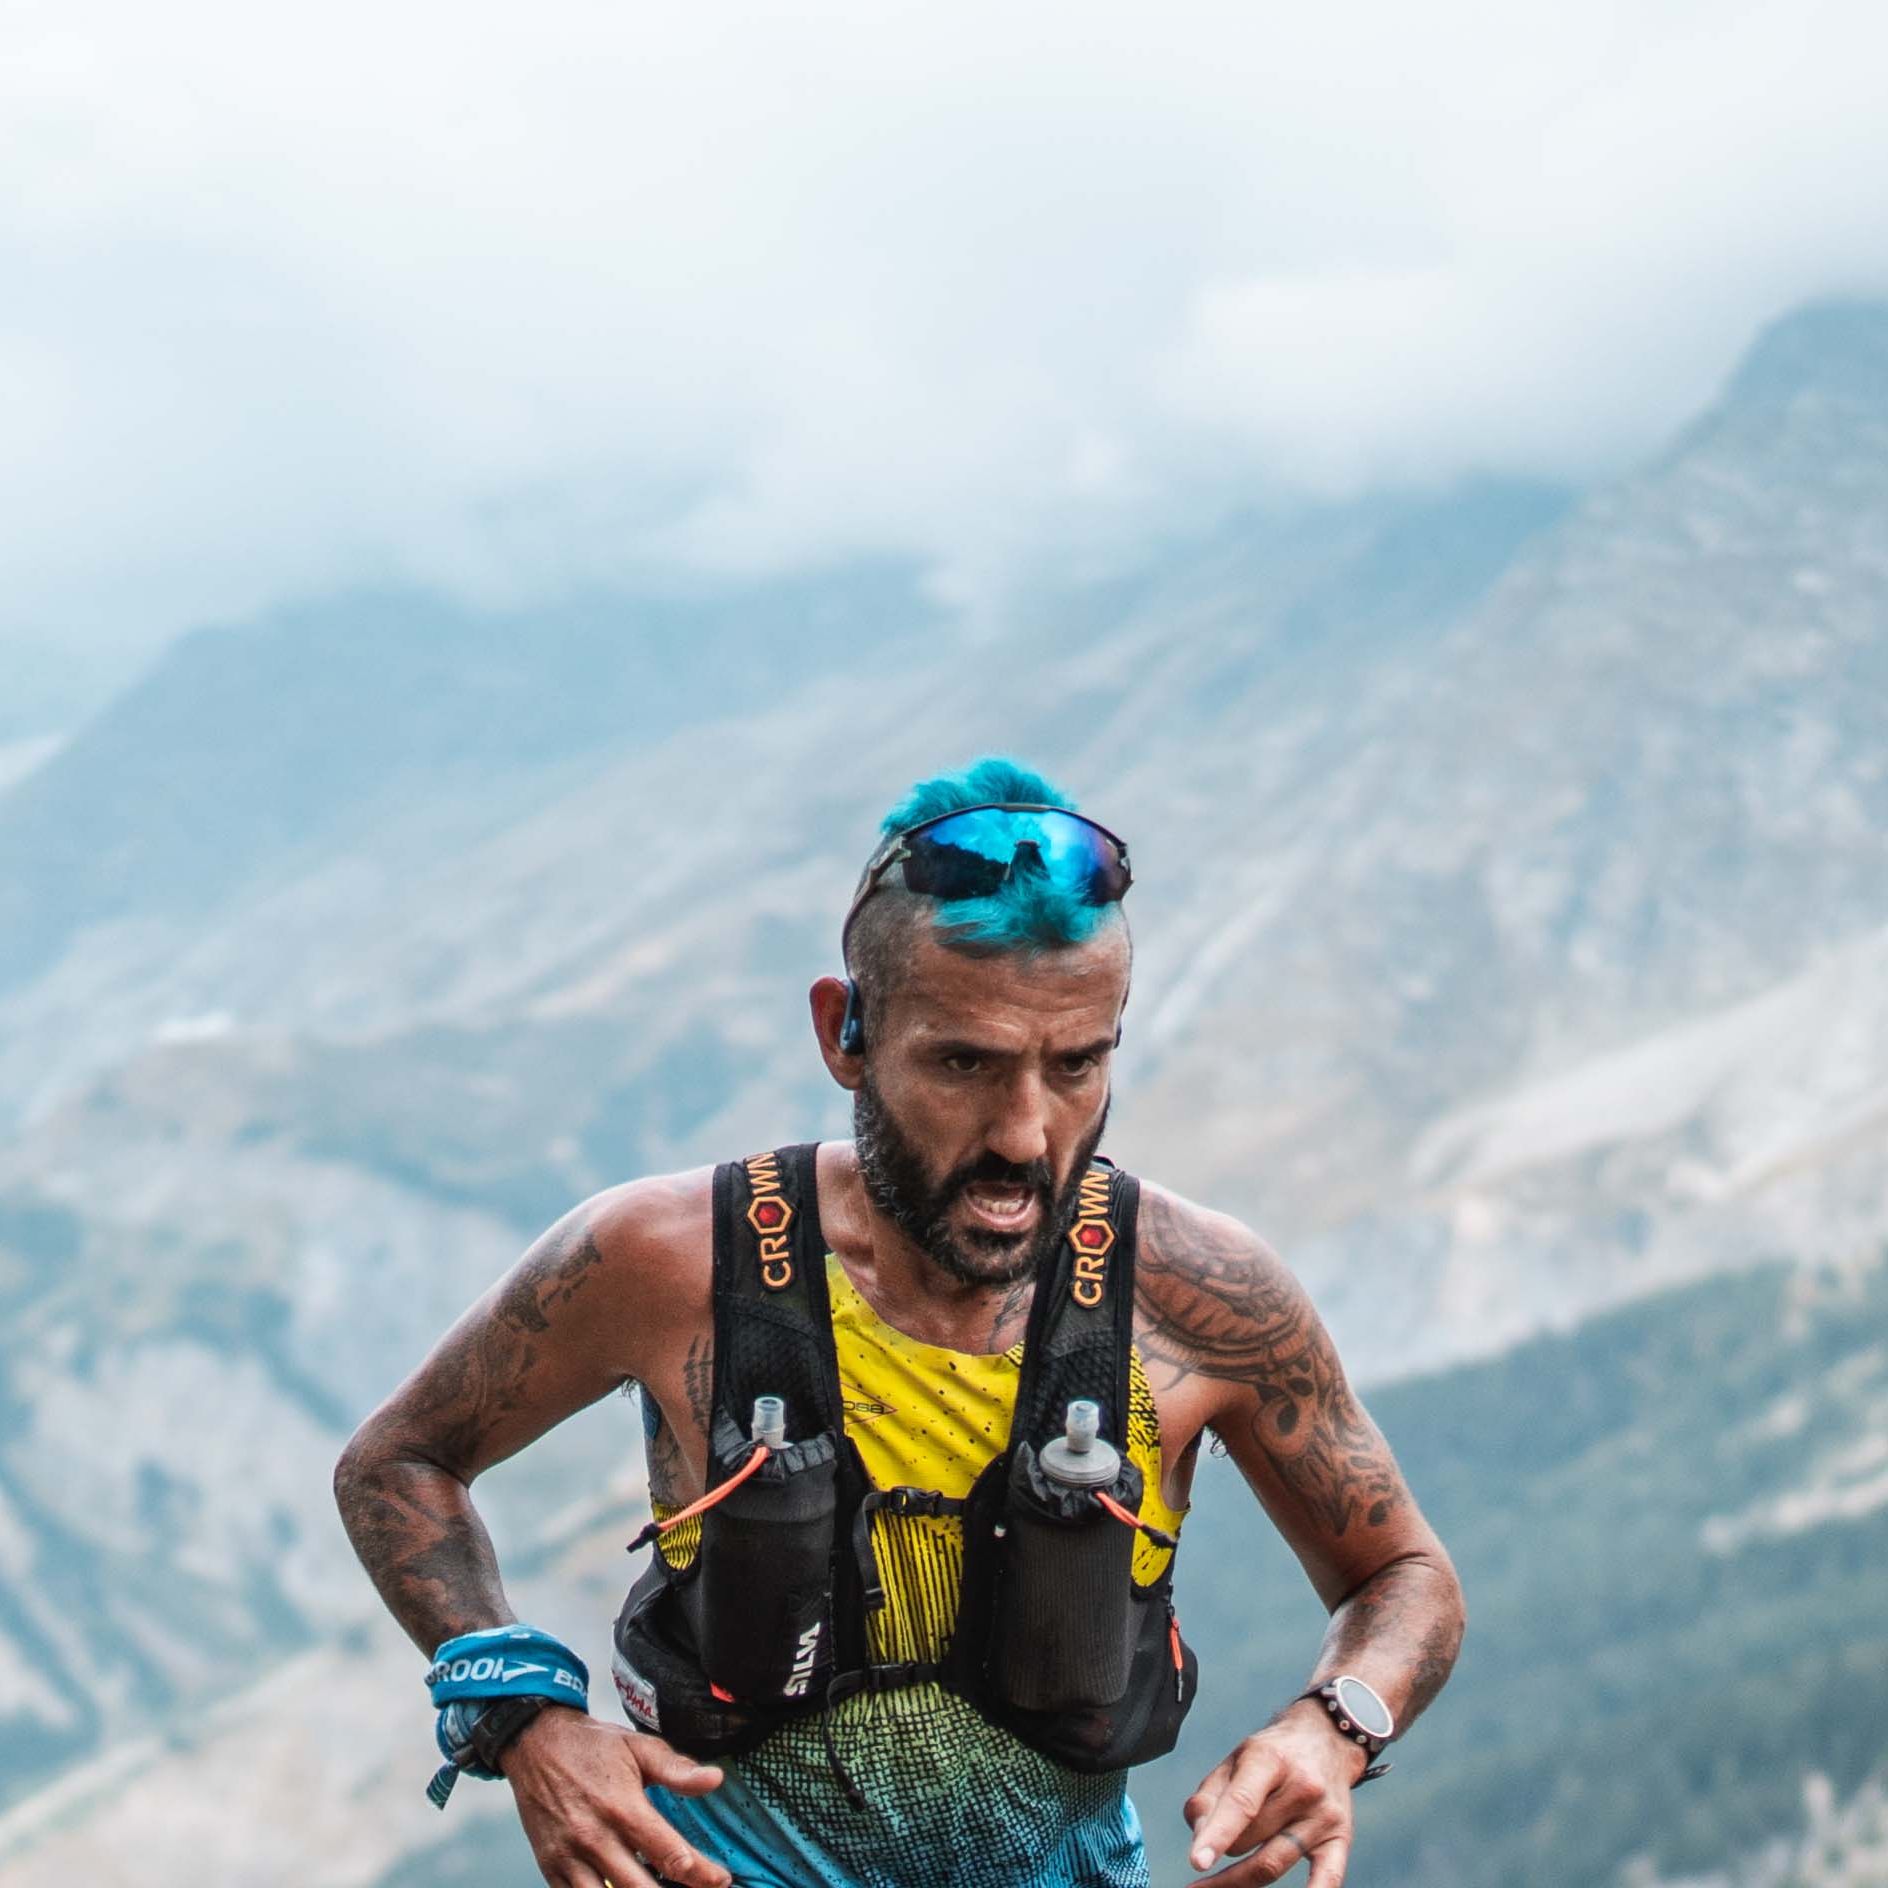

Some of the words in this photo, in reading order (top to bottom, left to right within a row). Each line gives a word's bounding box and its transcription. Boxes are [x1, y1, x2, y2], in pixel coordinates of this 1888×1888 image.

[746, 1152, 793, 1287] CROWN
[1070, 1170, 1115, 1306] CROWN
[783, 1621, 821, 1696] SILVA
